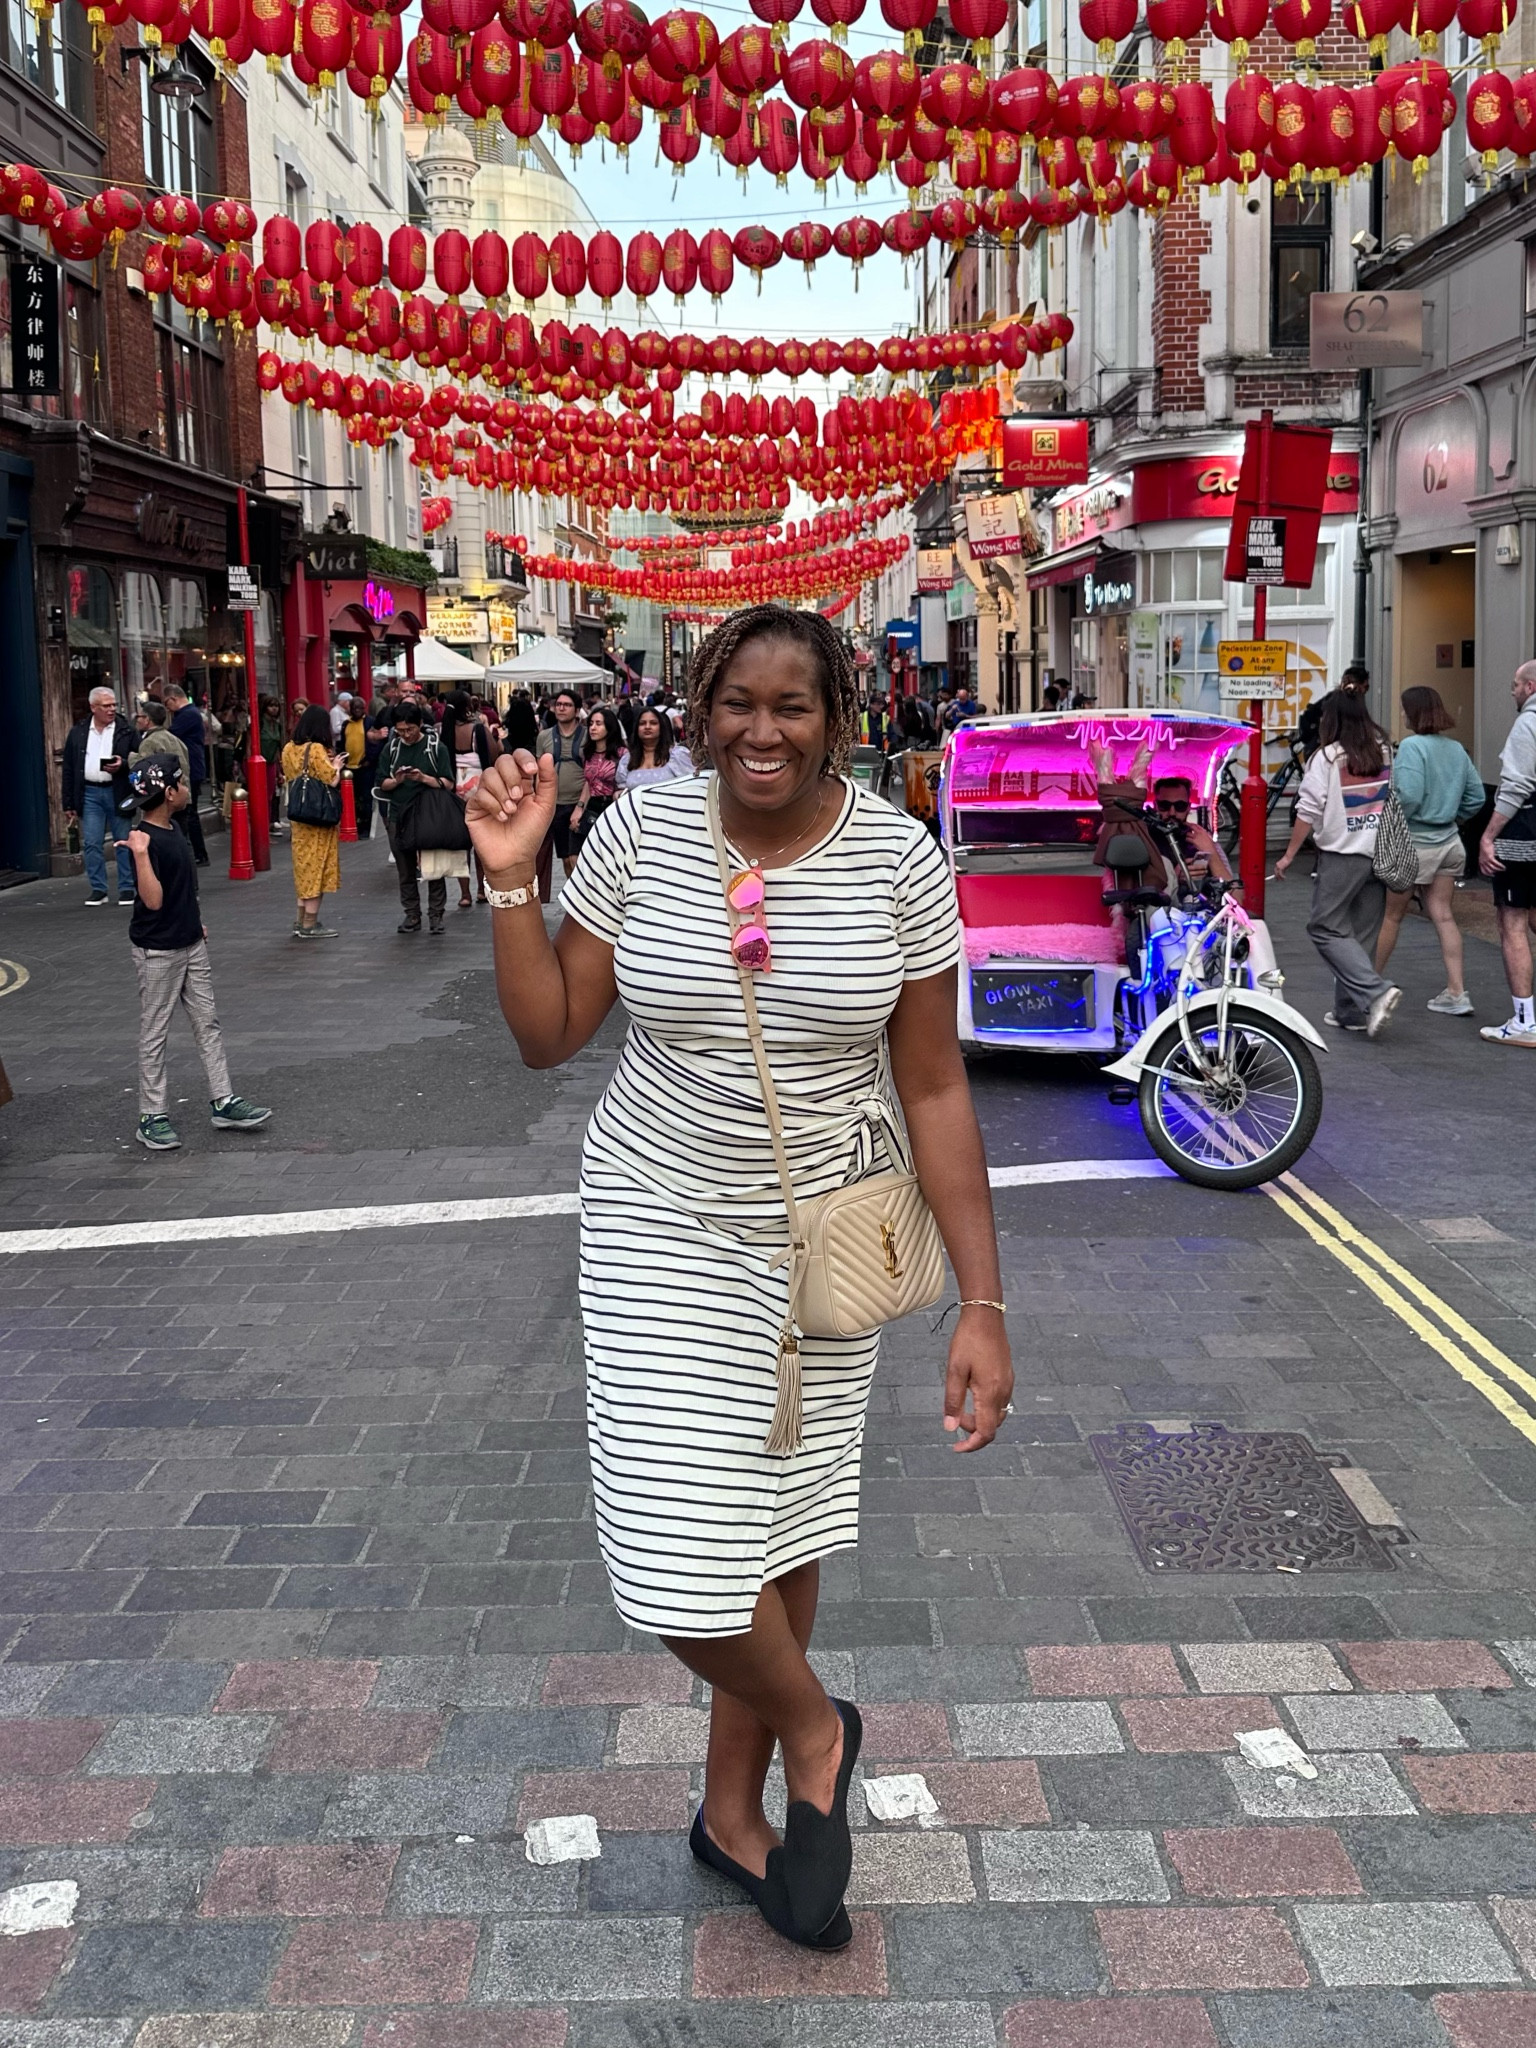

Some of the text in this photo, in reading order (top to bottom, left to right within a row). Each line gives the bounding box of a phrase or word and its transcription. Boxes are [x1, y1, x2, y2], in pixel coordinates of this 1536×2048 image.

[1343, 294, 1389, 333] 62
[26, 265, 45, 388] 东方律师楼
[1008, 459, 1085, 472] Gold Mine
[1423, 440, 1448, 493] 62
[980, 499, 1006, 537] 旺記
[1249, 520, 1274, 532] KARL
[1248, 533, 1276, 545] MARX
[971, 539, 1020, 556] Wong Kei
[1248, 546, 1283, 556] WALKING
[309, 547, 357, 572] Viet
[1262, 557, 1282, 567] TOUR
[228, 566, 248, 575] KARL
[228, 575, 251, 584] MARX
[919, 578, 952, 589] Wong Kei
[1243, 679, 1271, 687] loading
[1017, 996, 1053, 1014] TAXI
